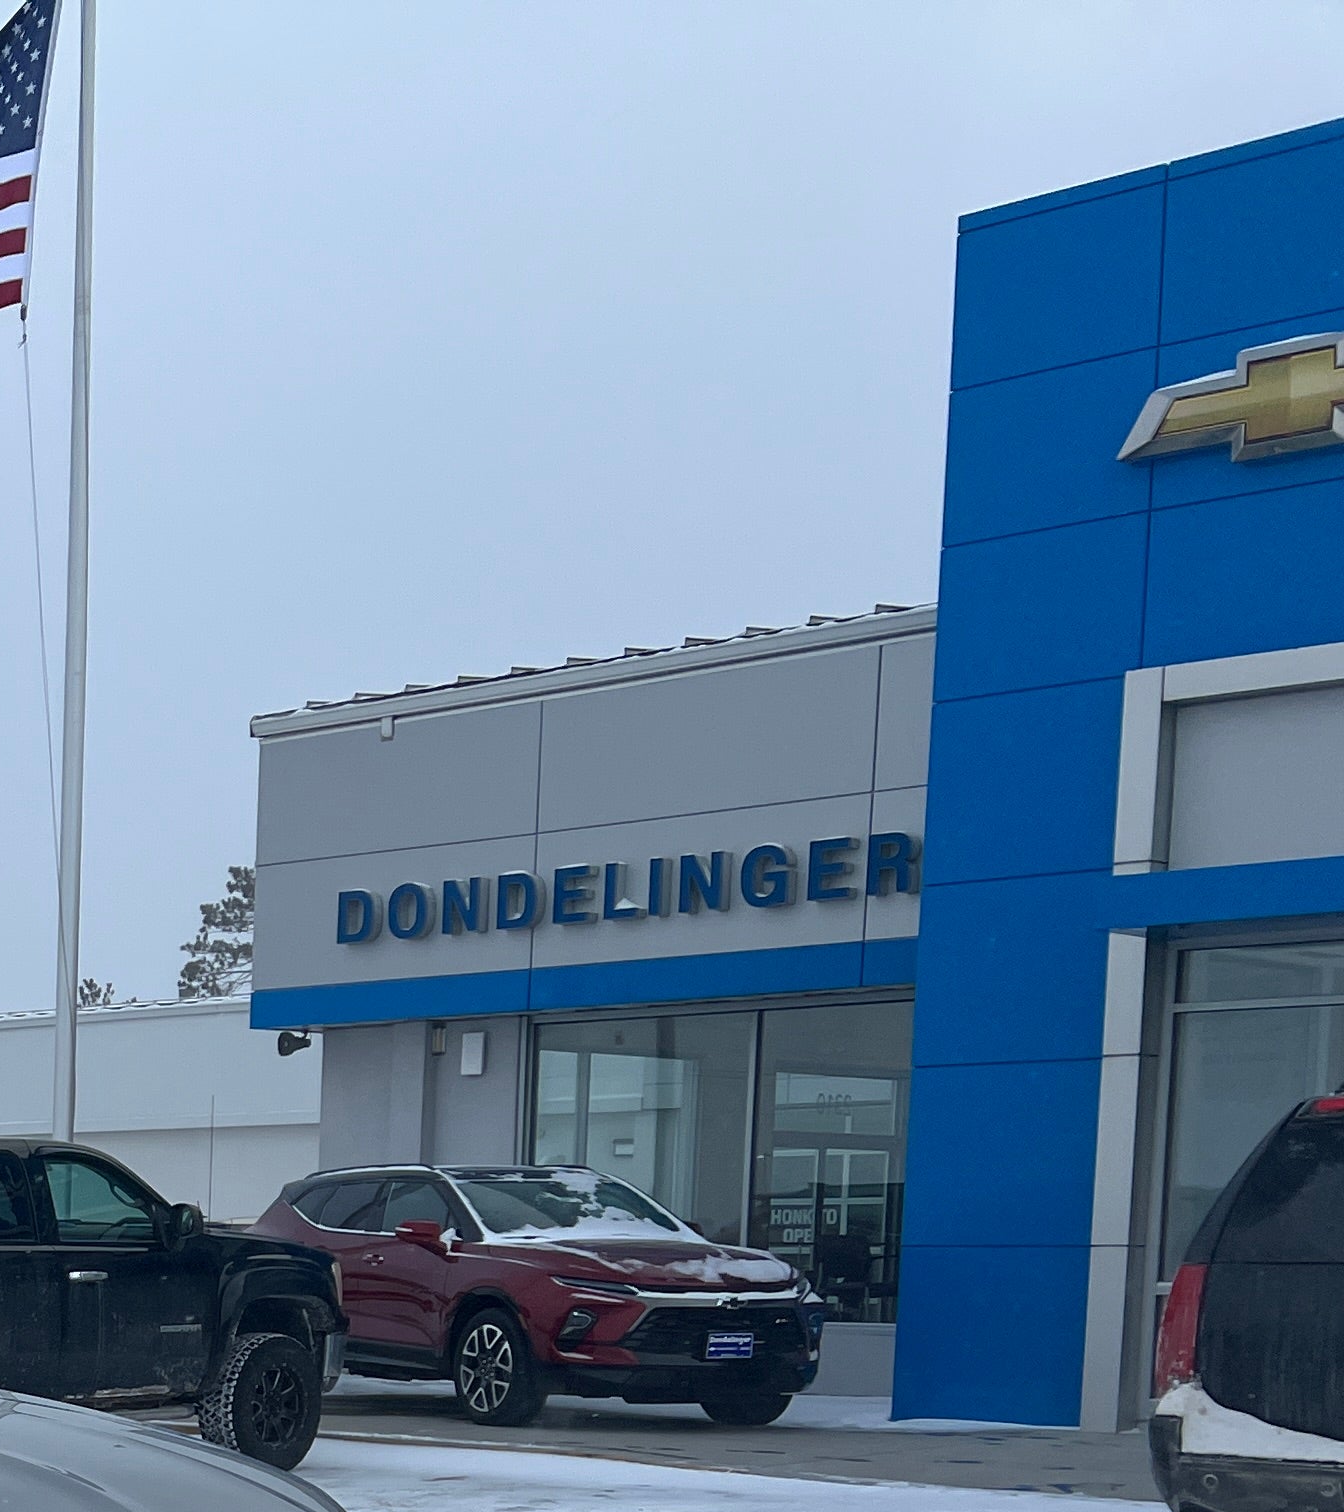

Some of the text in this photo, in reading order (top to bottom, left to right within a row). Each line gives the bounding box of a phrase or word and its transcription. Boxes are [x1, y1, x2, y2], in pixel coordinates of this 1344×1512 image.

[337, 831, 922, 945] DONDELINGER
[770, 1208, 813, 1225] HONK
[782, 1228, 813, 1243] OPE
